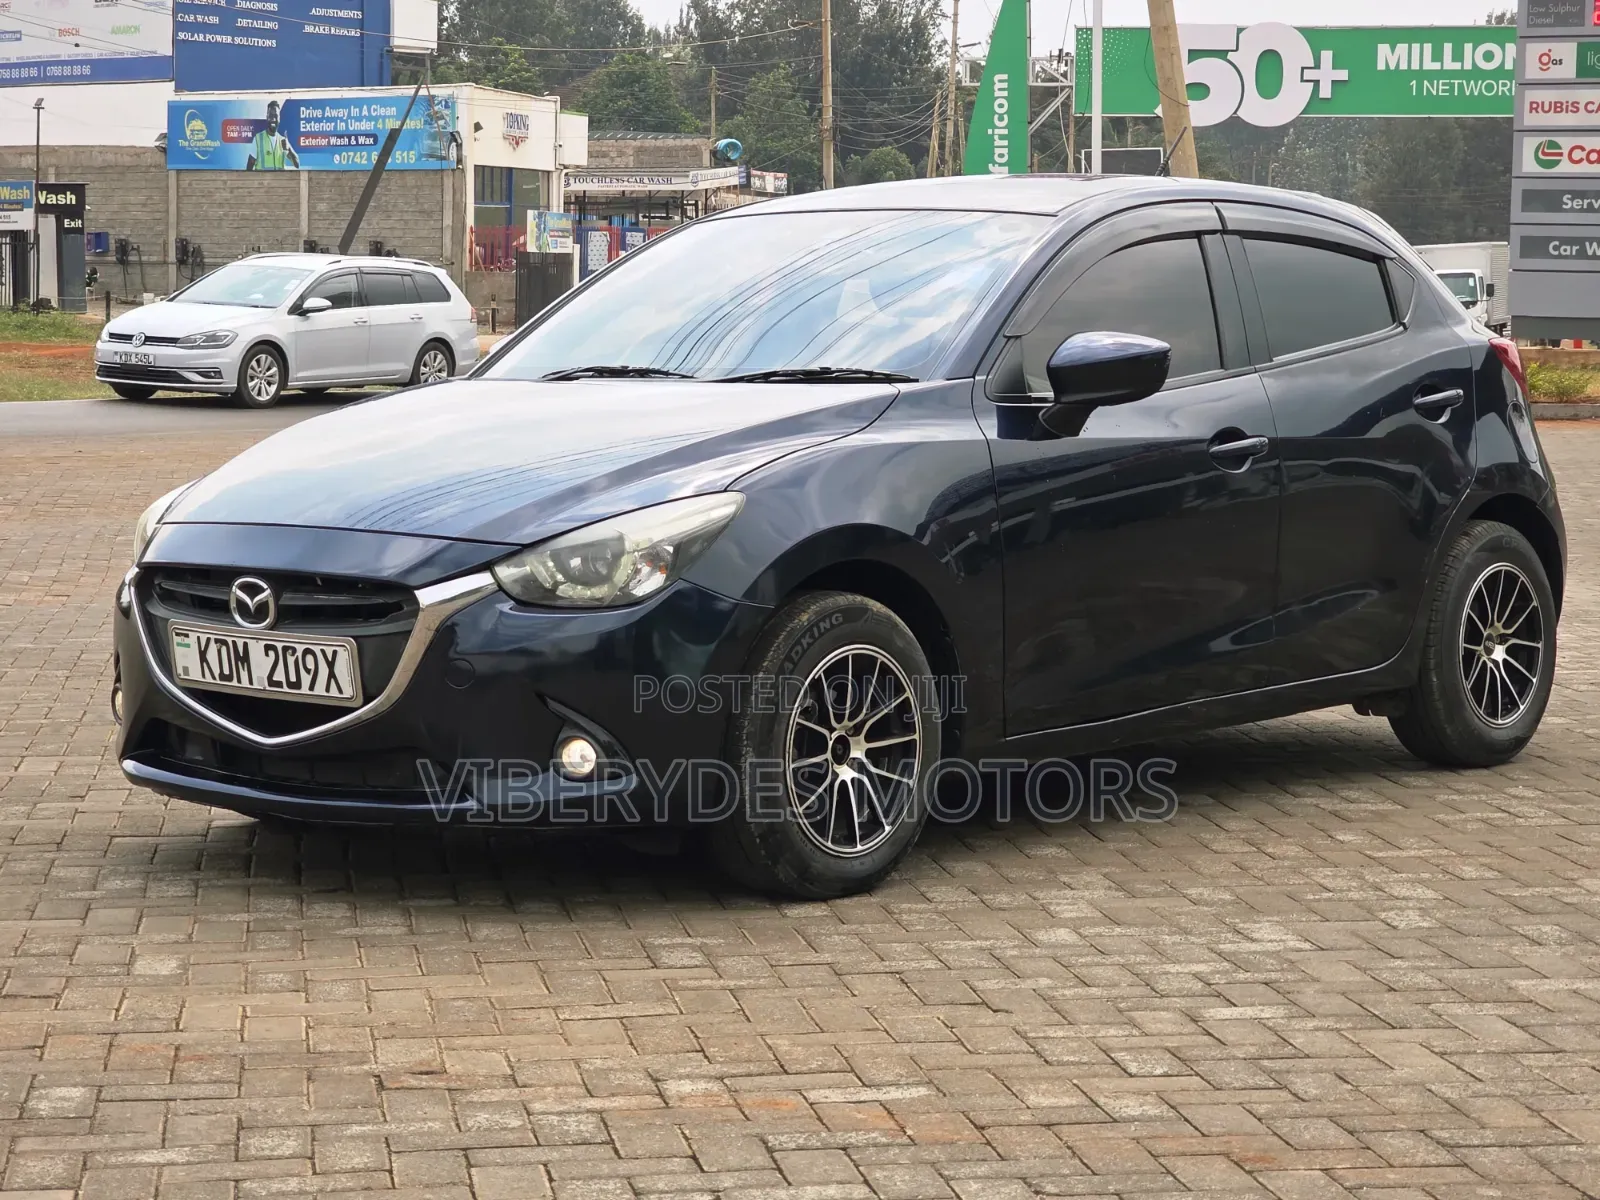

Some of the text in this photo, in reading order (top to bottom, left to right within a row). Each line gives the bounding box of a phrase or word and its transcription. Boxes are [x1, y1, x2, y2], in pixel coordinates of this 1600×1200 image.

[1529, 4, 1580, 15] Low Sulphur
[196, 15, 219, 24] WASH
[1529, 15, 1554, 25] Diesel
[58, 28, 80, 37] BOSCH
[331, 27, 360, 37] REPAIRS
[205, 34, 232, 44] POWER
[234, 37, 276, 47] SOLUTIONS
[1538, 48, 1563, 72] gas
[11, 68, 20, 78] 88
[20, 67, 28, 77] 88
[29, 67, 38, 77] 66
[46, 65, 91, 76] 0768 88 88 66
[1409, 80, 1516, 96] 1 NETWOR
[300, 104, 397, 119] Drive Away In A Clean
[300, 120, 334, 132] Exterior
[337, 120, 345, 131] In
[348, 119, 375, 131] Under
[376, 119, 382, 129] 4
[988, 74, 1008, 175] faricom
[300, 135, 374, 146] Exterior Wash & Wax
[341, 151, 367, 164] 0742
[395, 151, 416, 163] 515
[1567, 145, 1600, 165] Ca
[573, 176, 673, 184] TOUCHLESS CAR WASH
[1562, 194, 1600, 209] Serv
[64, 219, 82, 228] Exit
[1549, 241, 1579, 256] Car
[135, 355, 152, 364] 545L
[197, 635, 344, 694] KDM 209X
